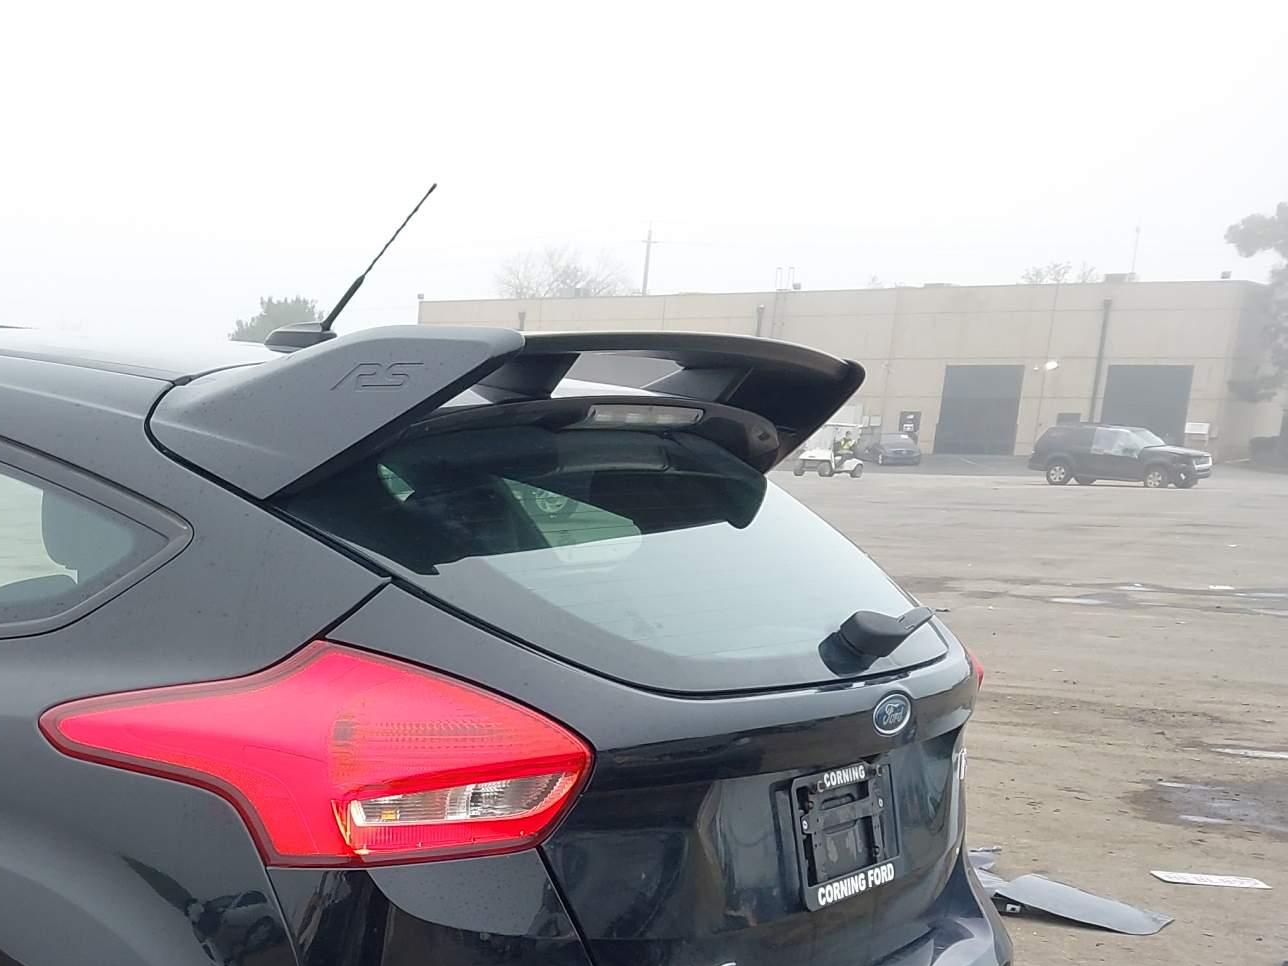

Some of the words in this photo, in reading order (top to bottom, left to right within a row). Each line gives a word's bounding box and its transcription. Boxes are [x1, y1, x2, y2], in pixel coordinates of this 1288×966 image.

[329, 361, 425, 392] RS
[823, 765, 866, 788] CORNING
[817, 872, 867, 906] CORNING
[867, 862, 895, 889] FORD
